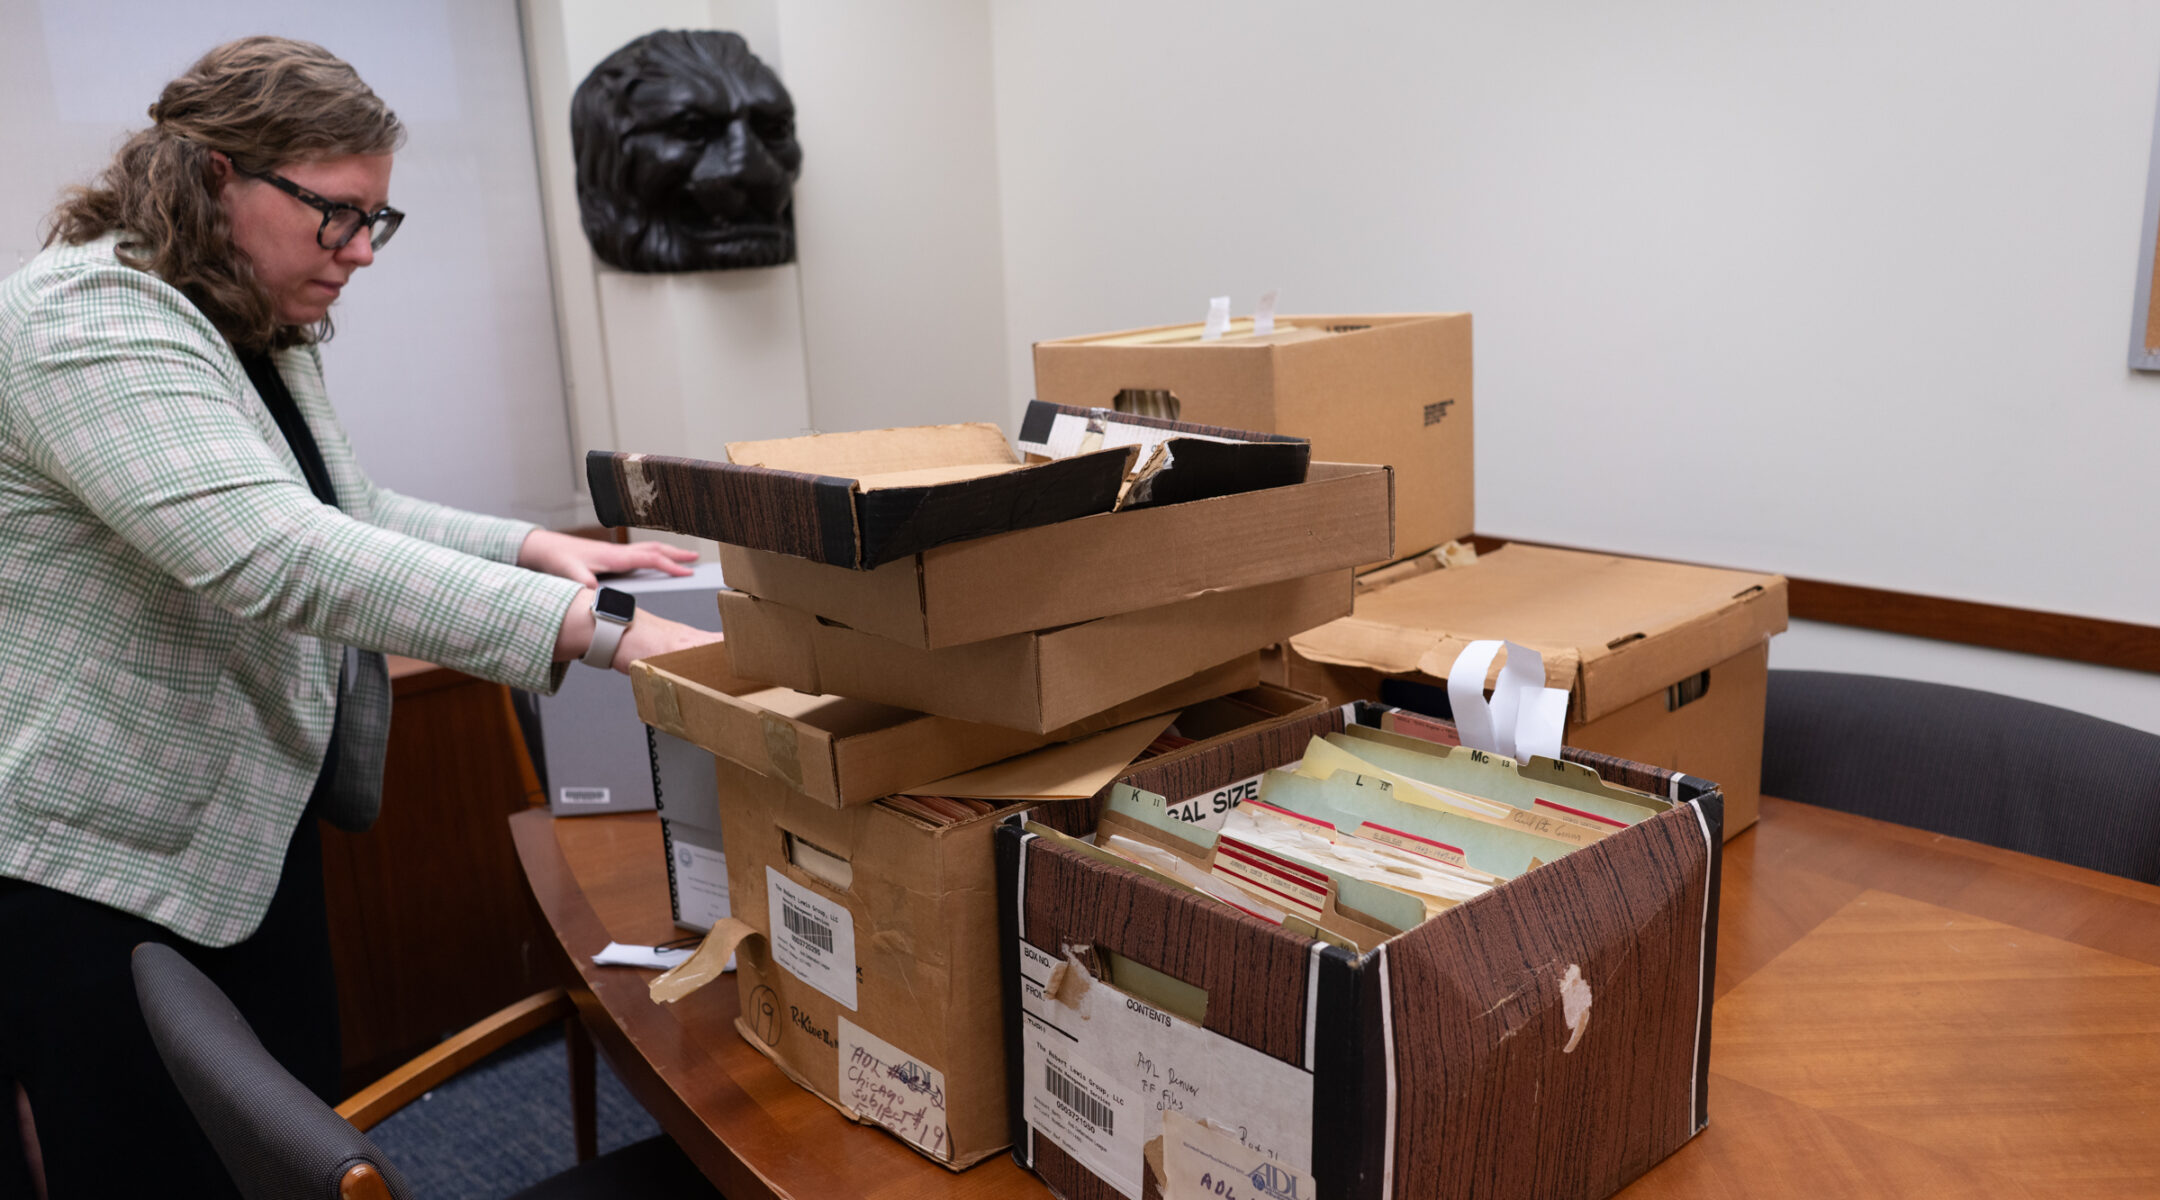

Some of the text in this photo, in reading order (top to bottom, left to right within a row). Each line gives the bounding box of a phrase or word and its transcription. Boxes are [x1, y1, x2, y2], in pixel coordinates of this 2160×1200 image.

[1471, 750, 1510, 768] Mc 13
[1553, 760, 1565, 772] M
[1355, 774, 1364, 786] L
[1131, 789, 1140, 802] K
[1213, 780, 1258, 814] SIZE
[1024, 947, 1038, 962] BOX
[756, 997, 774, 1046] 19
[1127, 998, 1171, 1028] CONTENTS
[1048, 1050, 1067, 1066] Robert
[1070, 1066, 1086, 1081] Lewis
[1089, 1079, 1109, 1097] Group,
[1113, 1094, 1125, 1106] LLC
